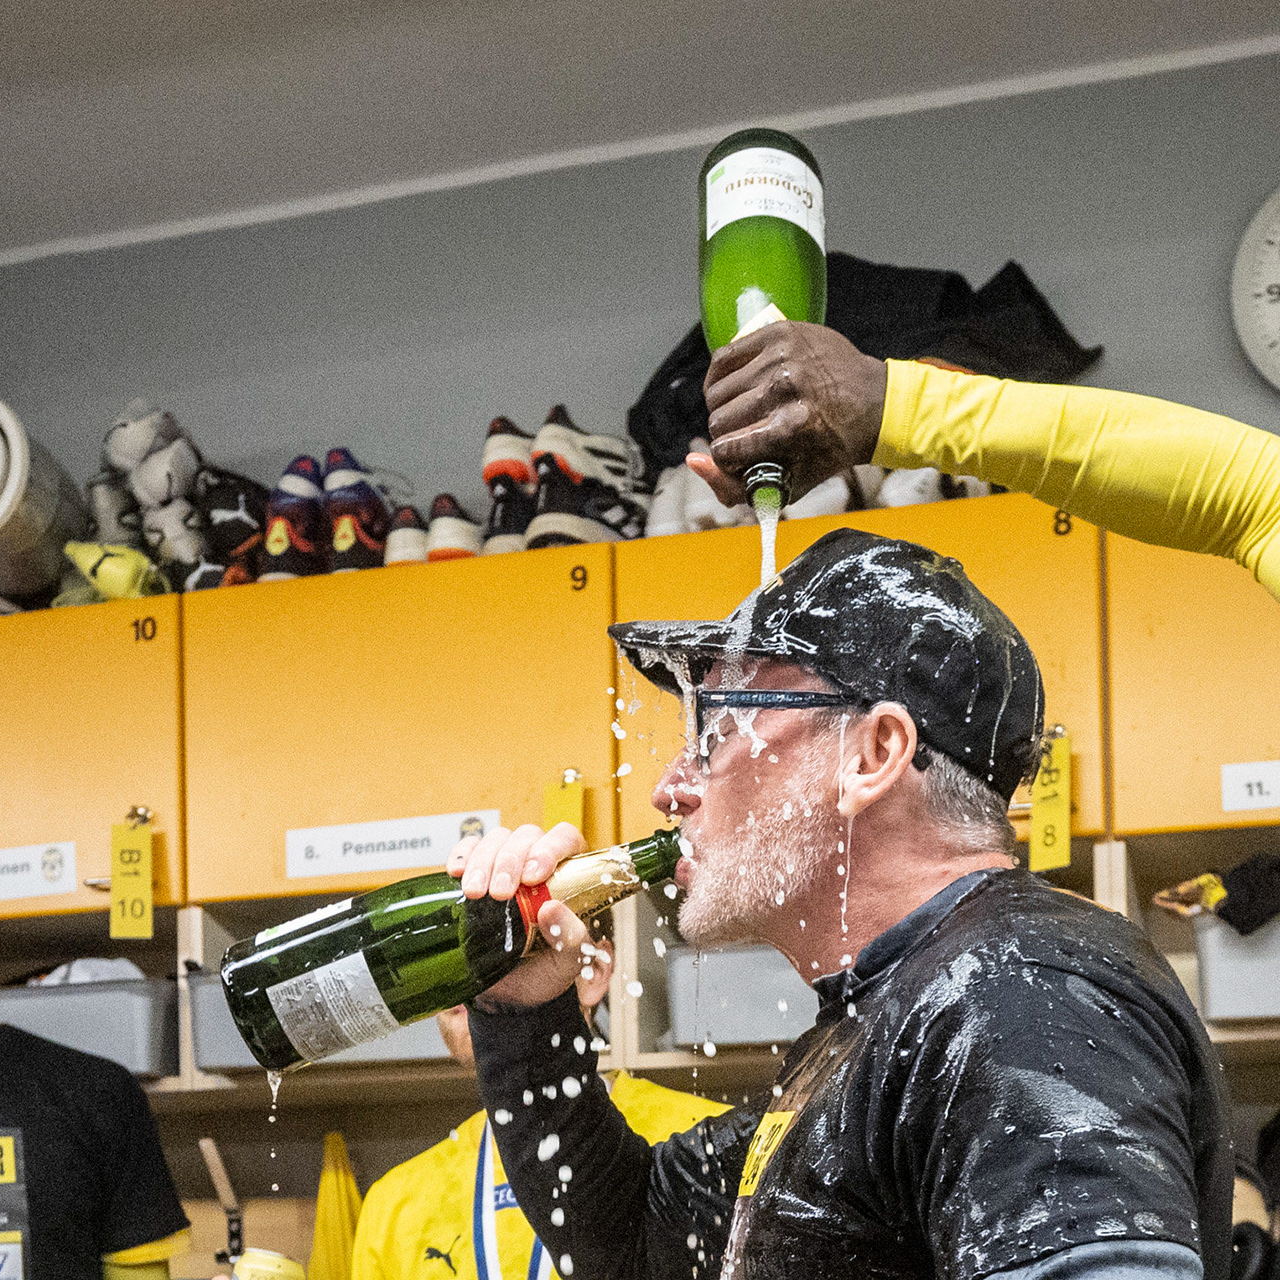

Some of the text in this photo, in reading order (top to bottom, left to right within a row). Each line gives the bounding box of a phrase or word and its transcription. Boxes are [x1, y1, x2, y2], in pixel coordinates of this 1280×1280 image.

[1053, 508, 1073, 536] 8
[569, 564, 588, 592] 9
[130, 616, 158, 641] 10
[341, 835, 431, 857] Pennanen
[1043, 824, 1057, 847] 8
[117, 898, 146, 919] 10
